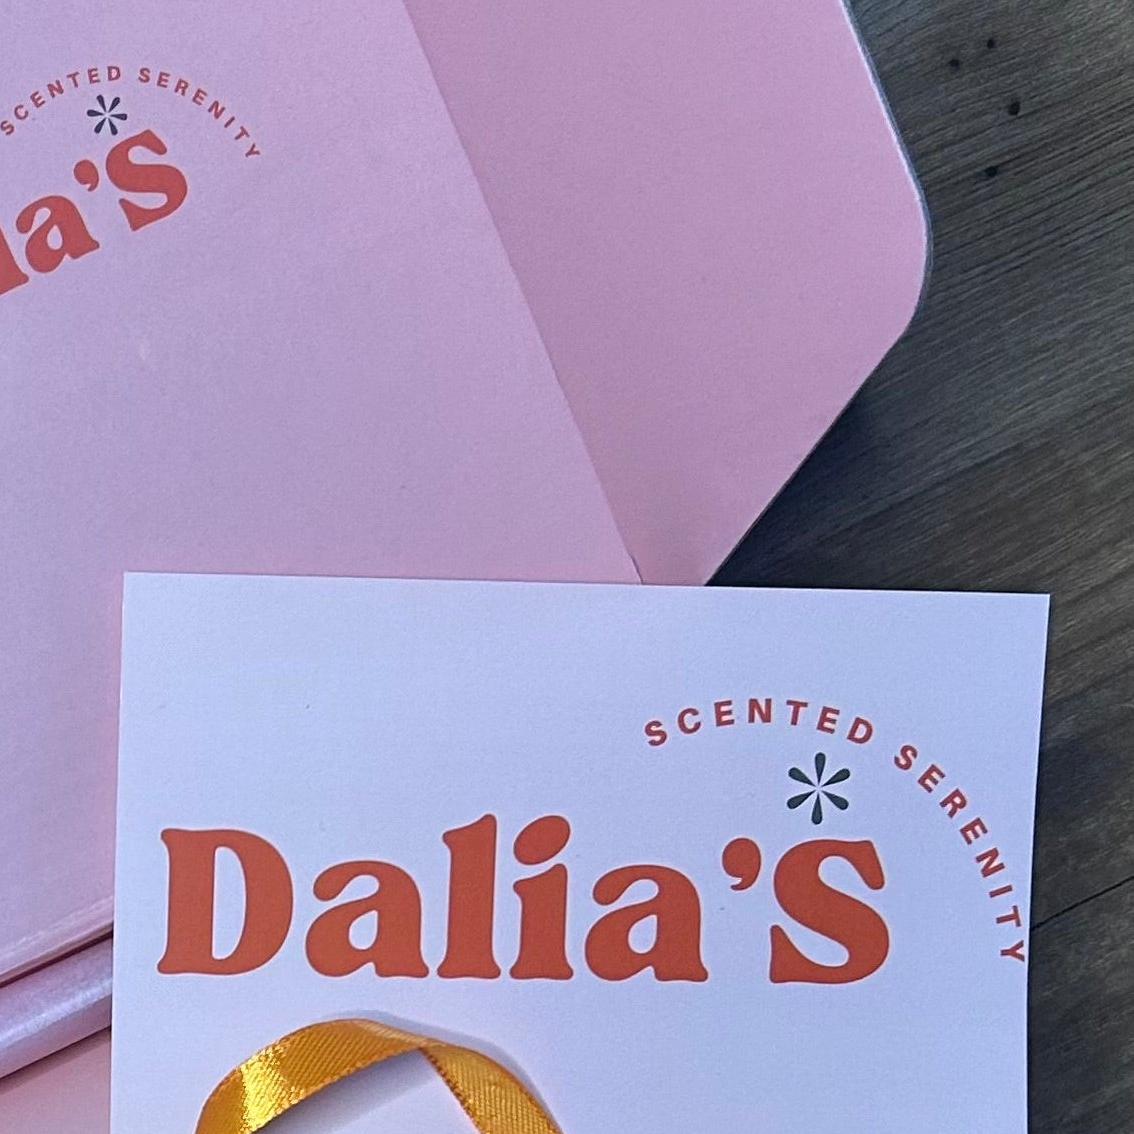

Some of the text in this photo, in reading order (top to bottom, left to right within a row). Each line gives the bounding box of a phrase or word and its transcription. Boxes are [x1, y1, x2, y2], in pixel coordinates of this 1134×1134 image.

[0, 65, 261, 161] SCENTED SERENITY
[157, 812, 890, 985] Dalia'S
[644, 697, 1026, 963] SCENTED SERENITY
